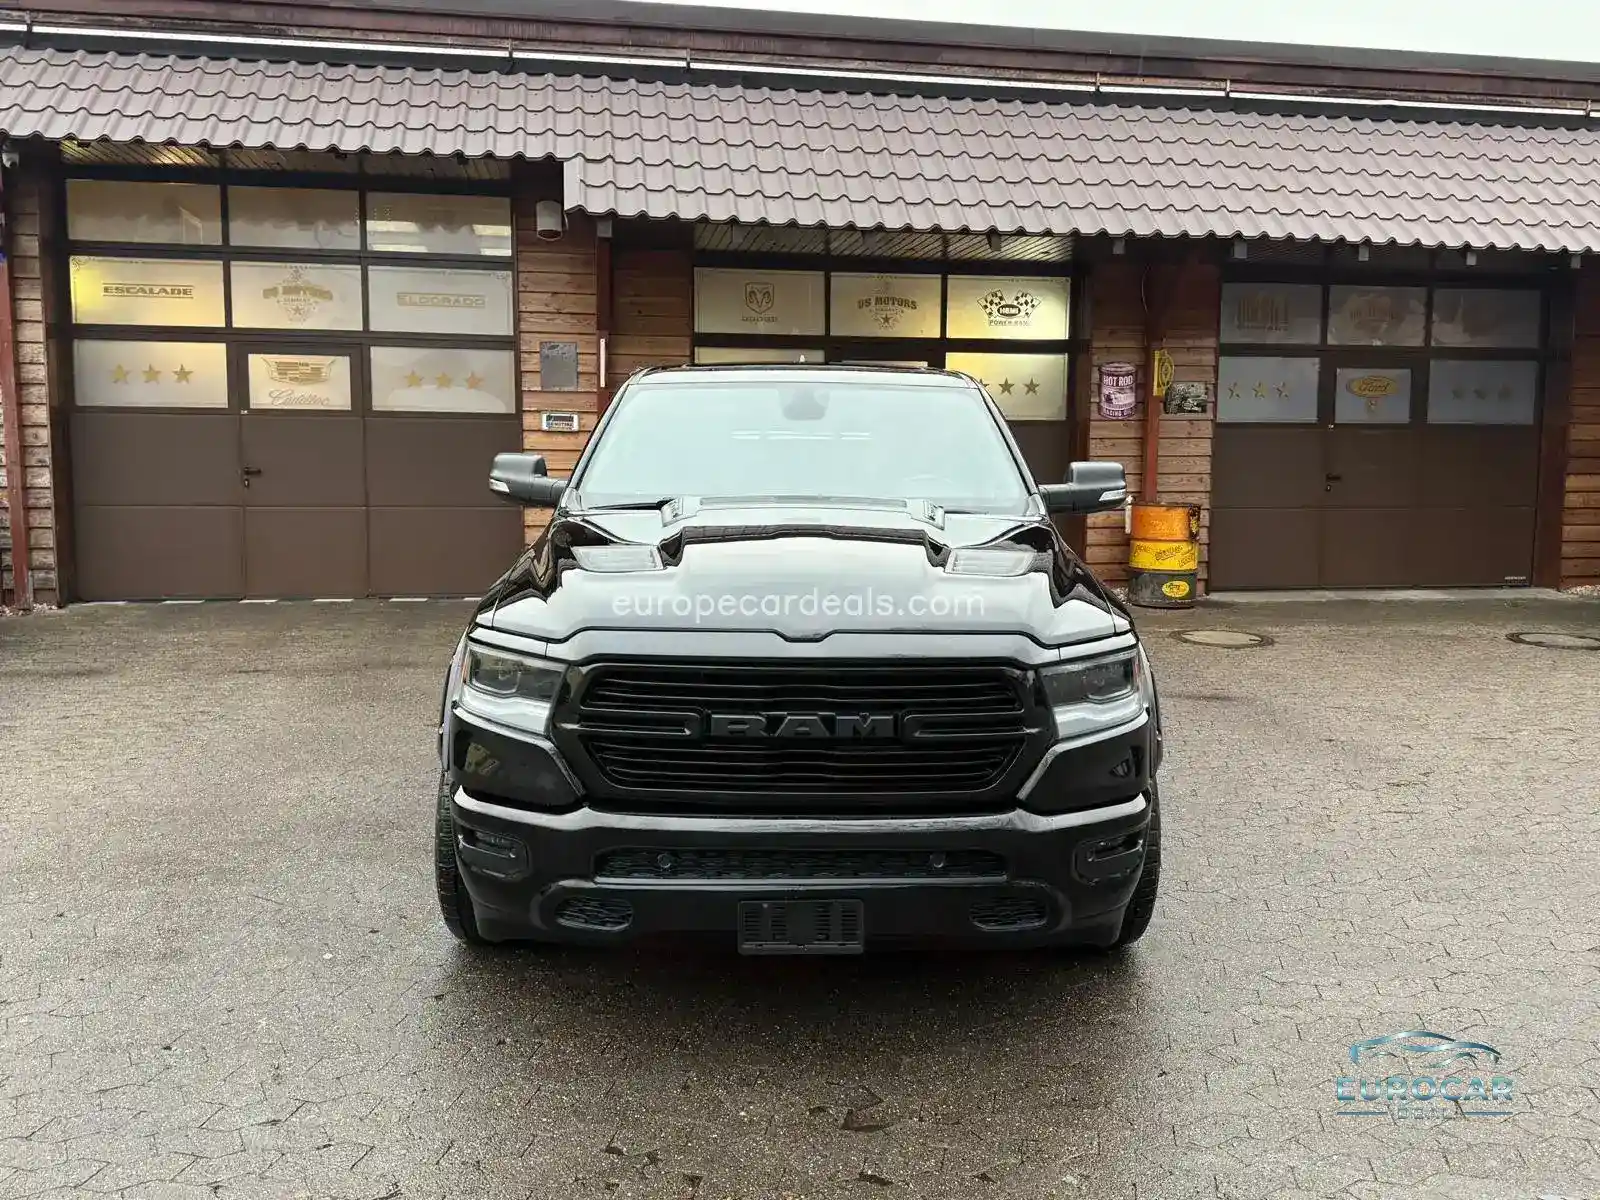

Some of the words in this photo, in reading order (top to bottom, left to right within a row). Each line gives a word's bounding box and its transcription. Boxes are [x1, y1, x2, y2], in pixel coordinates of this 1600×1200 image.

[103, 286, 193, 296] ESCALADE
[858, 298, 871, 310] US
[874, 296, 917, 310] MOTORS
[1103, 376, 1117, 386] HOT
[1118, 375, 1133, 387] ROD
[711, 713, 895, 738] RAM
